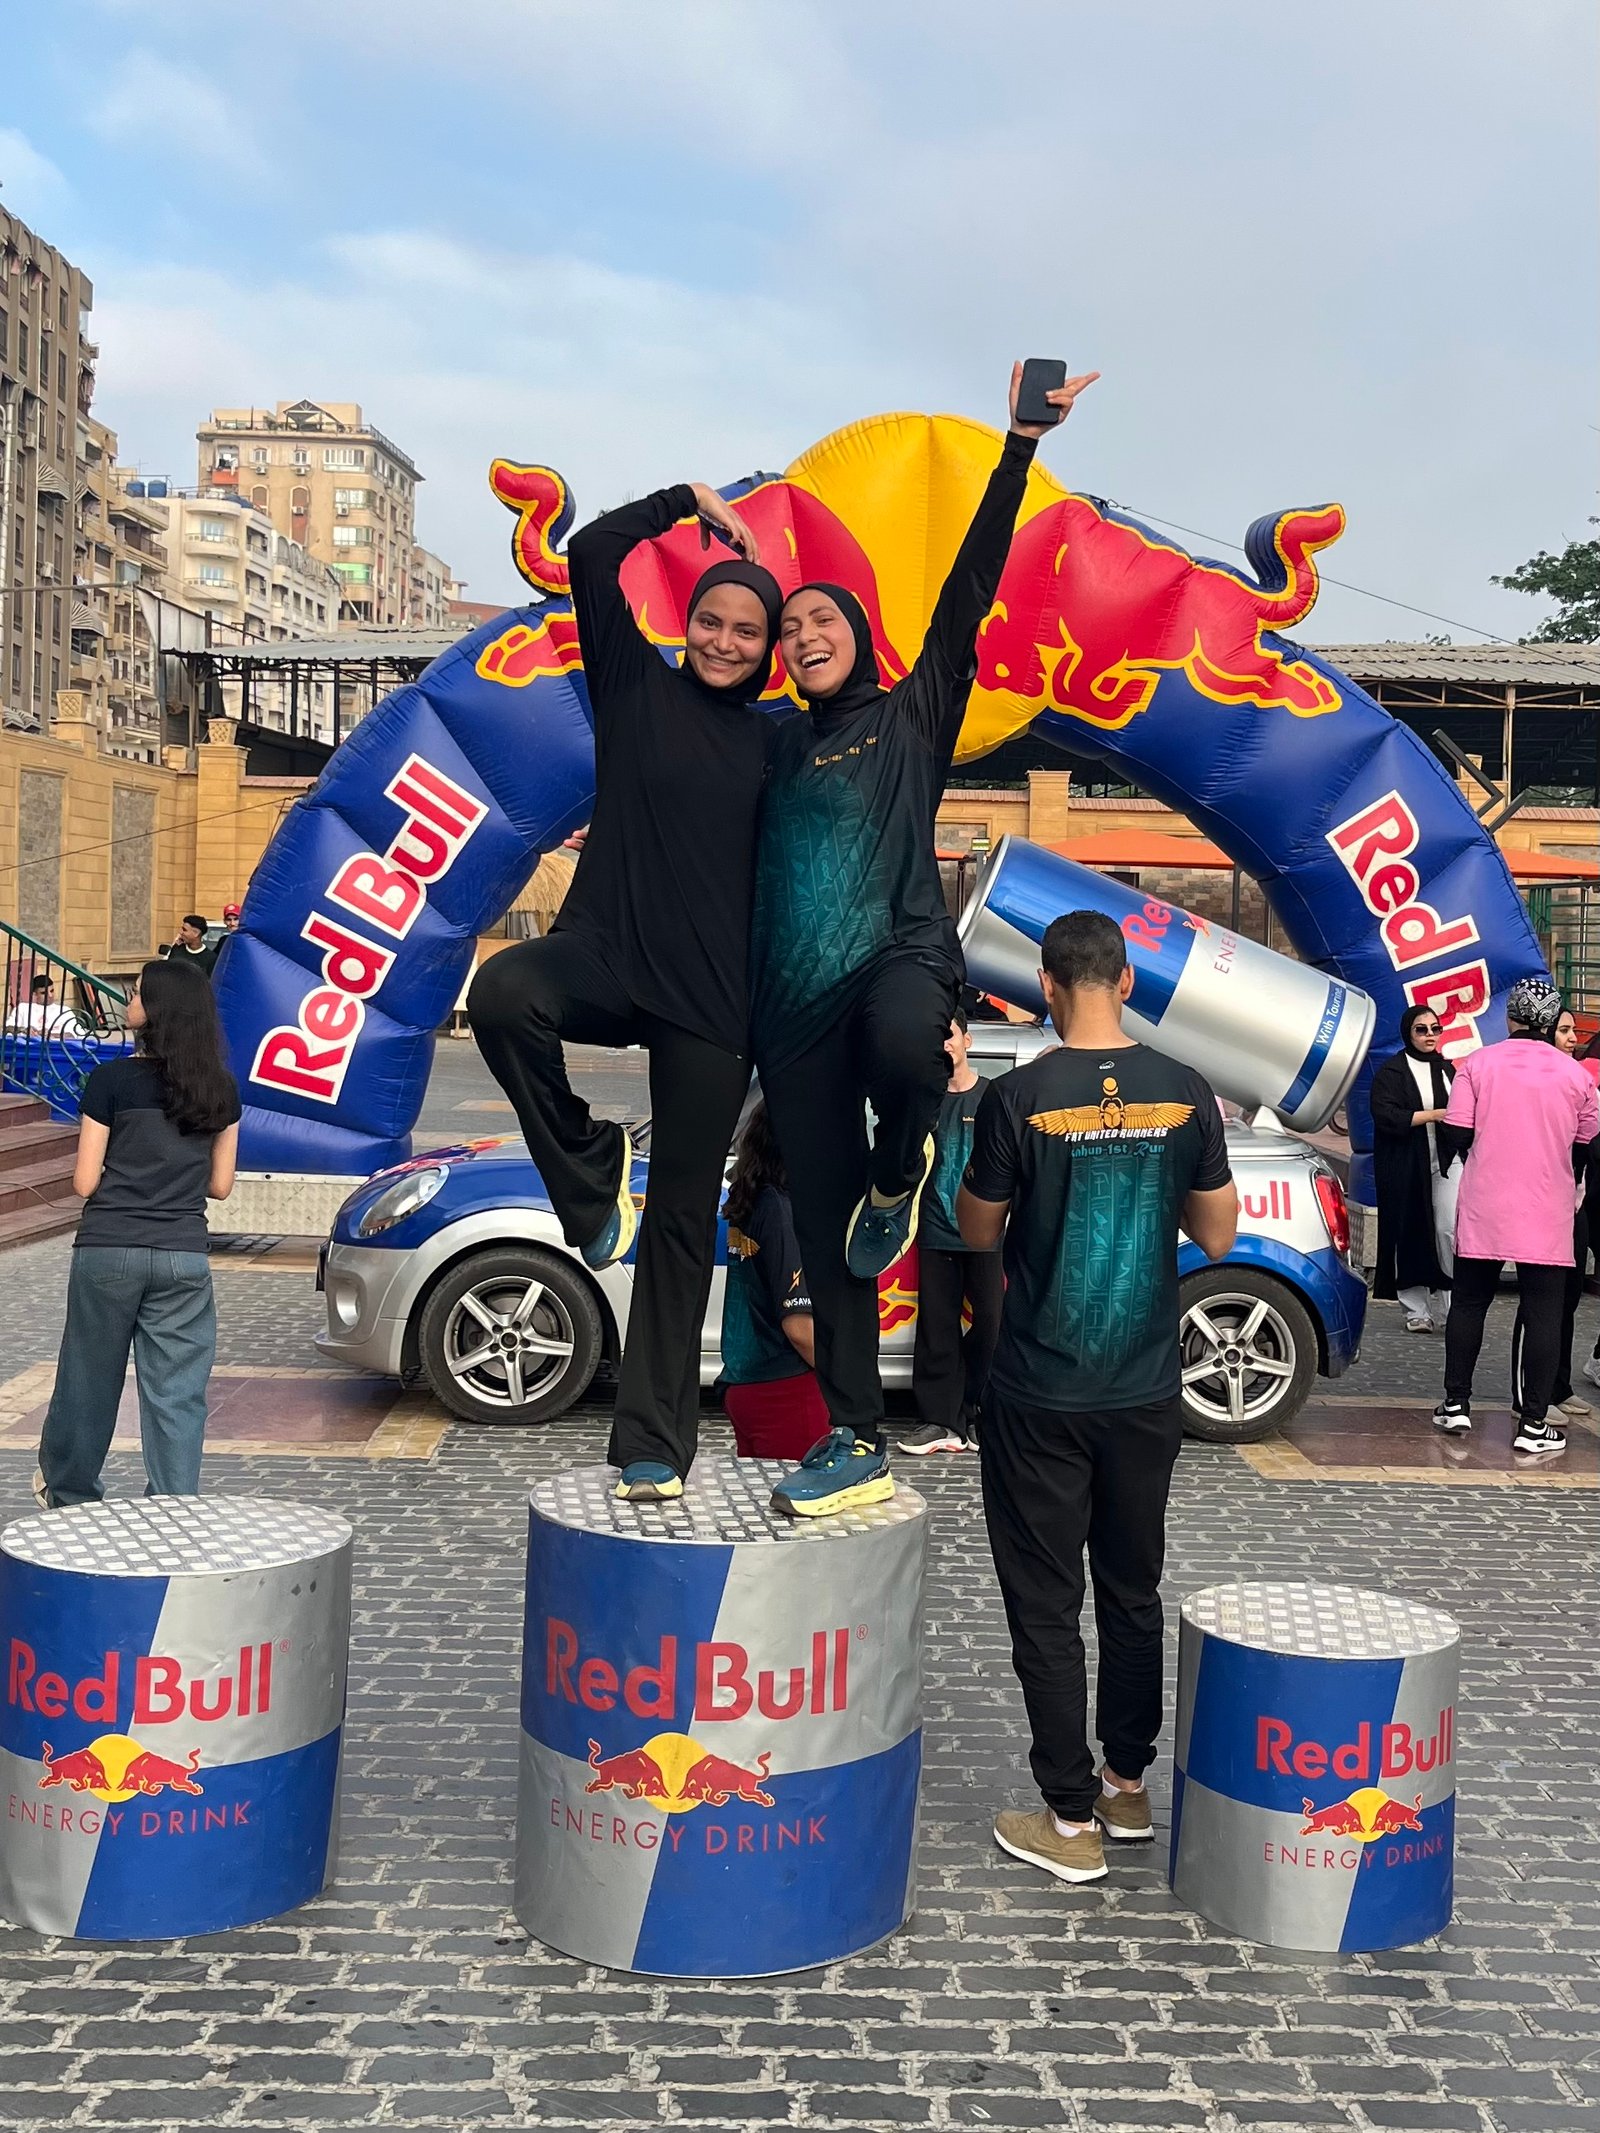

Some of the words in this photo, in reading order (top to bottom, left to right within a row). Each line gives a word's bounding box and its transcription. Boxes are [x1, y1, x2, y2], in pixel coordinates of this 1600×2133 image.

[1332, 796, 1473, 965] Red
[255, 918, 395, 1099] Red
[331, 760, 481, 933] Bull
[1316, 1020, 1335, 1045] With
[1064, 1132, 1083, 1143] FAT
[1084, 1129, 1118, 1141] UNITED
[1119, 1127, 1168, 1139] RUNNERS
[1232, 1180, 1292, 1220] ull
[9, 1638, 120, 1724] Red
[133, 1642, 273, 1726] Bull
[545, 1617, 677, 1722] Red
[693, 1628, 850, 1723] Bull
[1255, 1714, 1371, 1781] Red
[1380, 1705, 1453, 1780] Bull
[8, 1801, 124, 1837] ENERGY
[140, 1800, 253, 1838] DRINK
[550, 1798, 687, 1854] ENERGY
[705, 1814, 829, 1856] DRINK
[1263, 1842, 1377, 1871] ENERGY
[1386, 1833, 1446, 1868] DRINK
